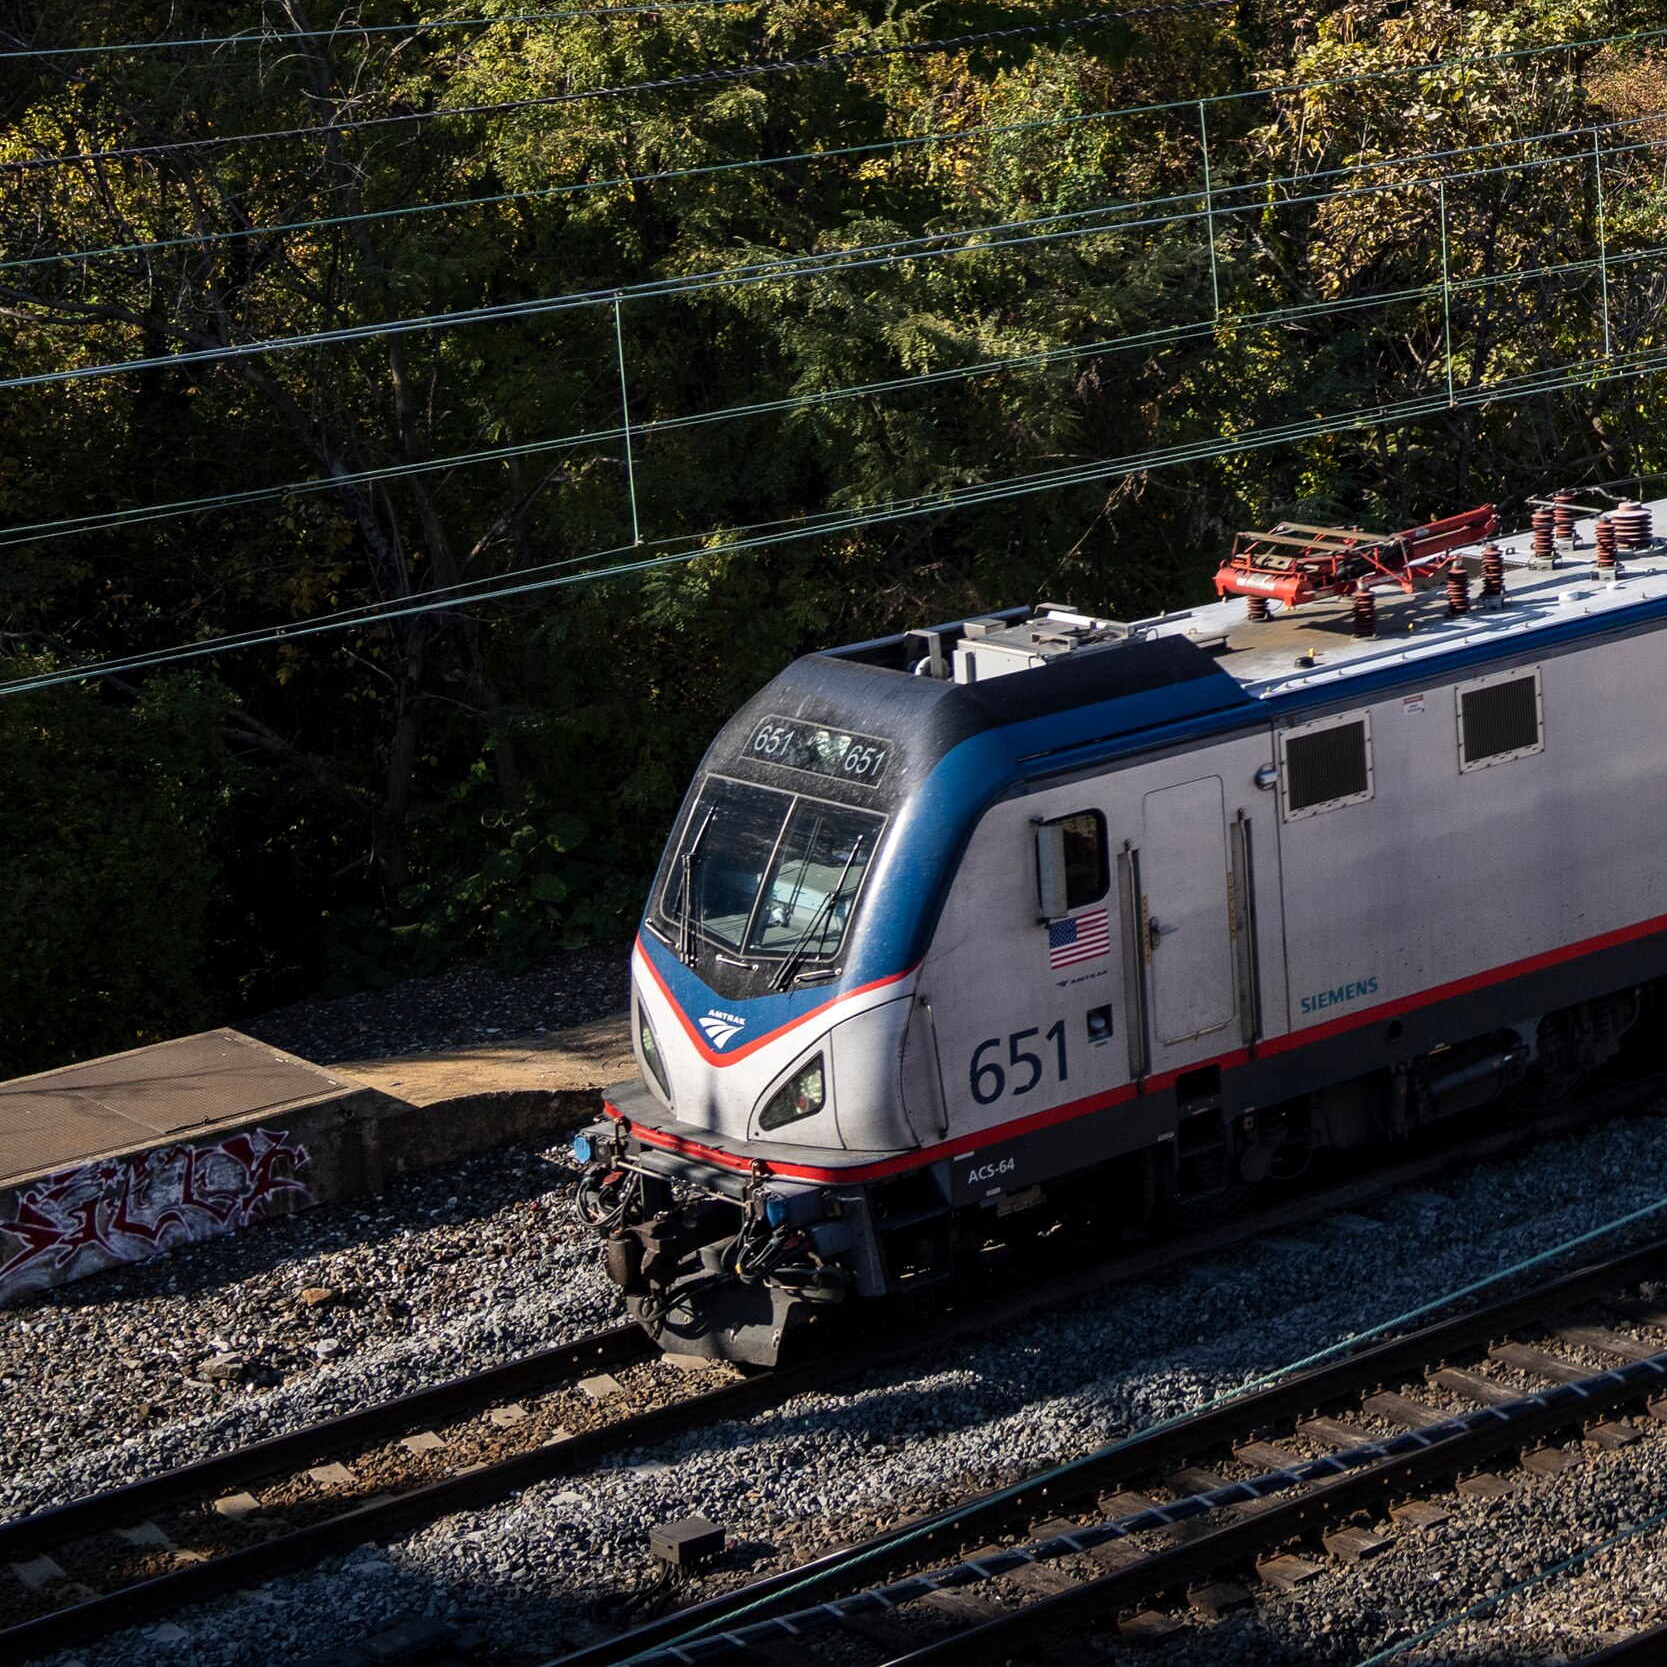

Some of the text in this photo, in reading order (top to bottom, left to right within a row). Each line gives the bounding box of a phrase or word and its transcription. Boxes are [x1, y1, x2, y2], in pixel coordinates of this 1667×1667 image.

[754, 724, 887, 776] 651 651
[1069, 969, 1109, 985] AMTRAK
[1300, 977, 1379, 1014] SIEMENS
[707, 1009, 746, 1026] AMTRAK
[969, 1018, 1068, 1106] 651
[967, 1157, 1016, 1184] ACS-64
